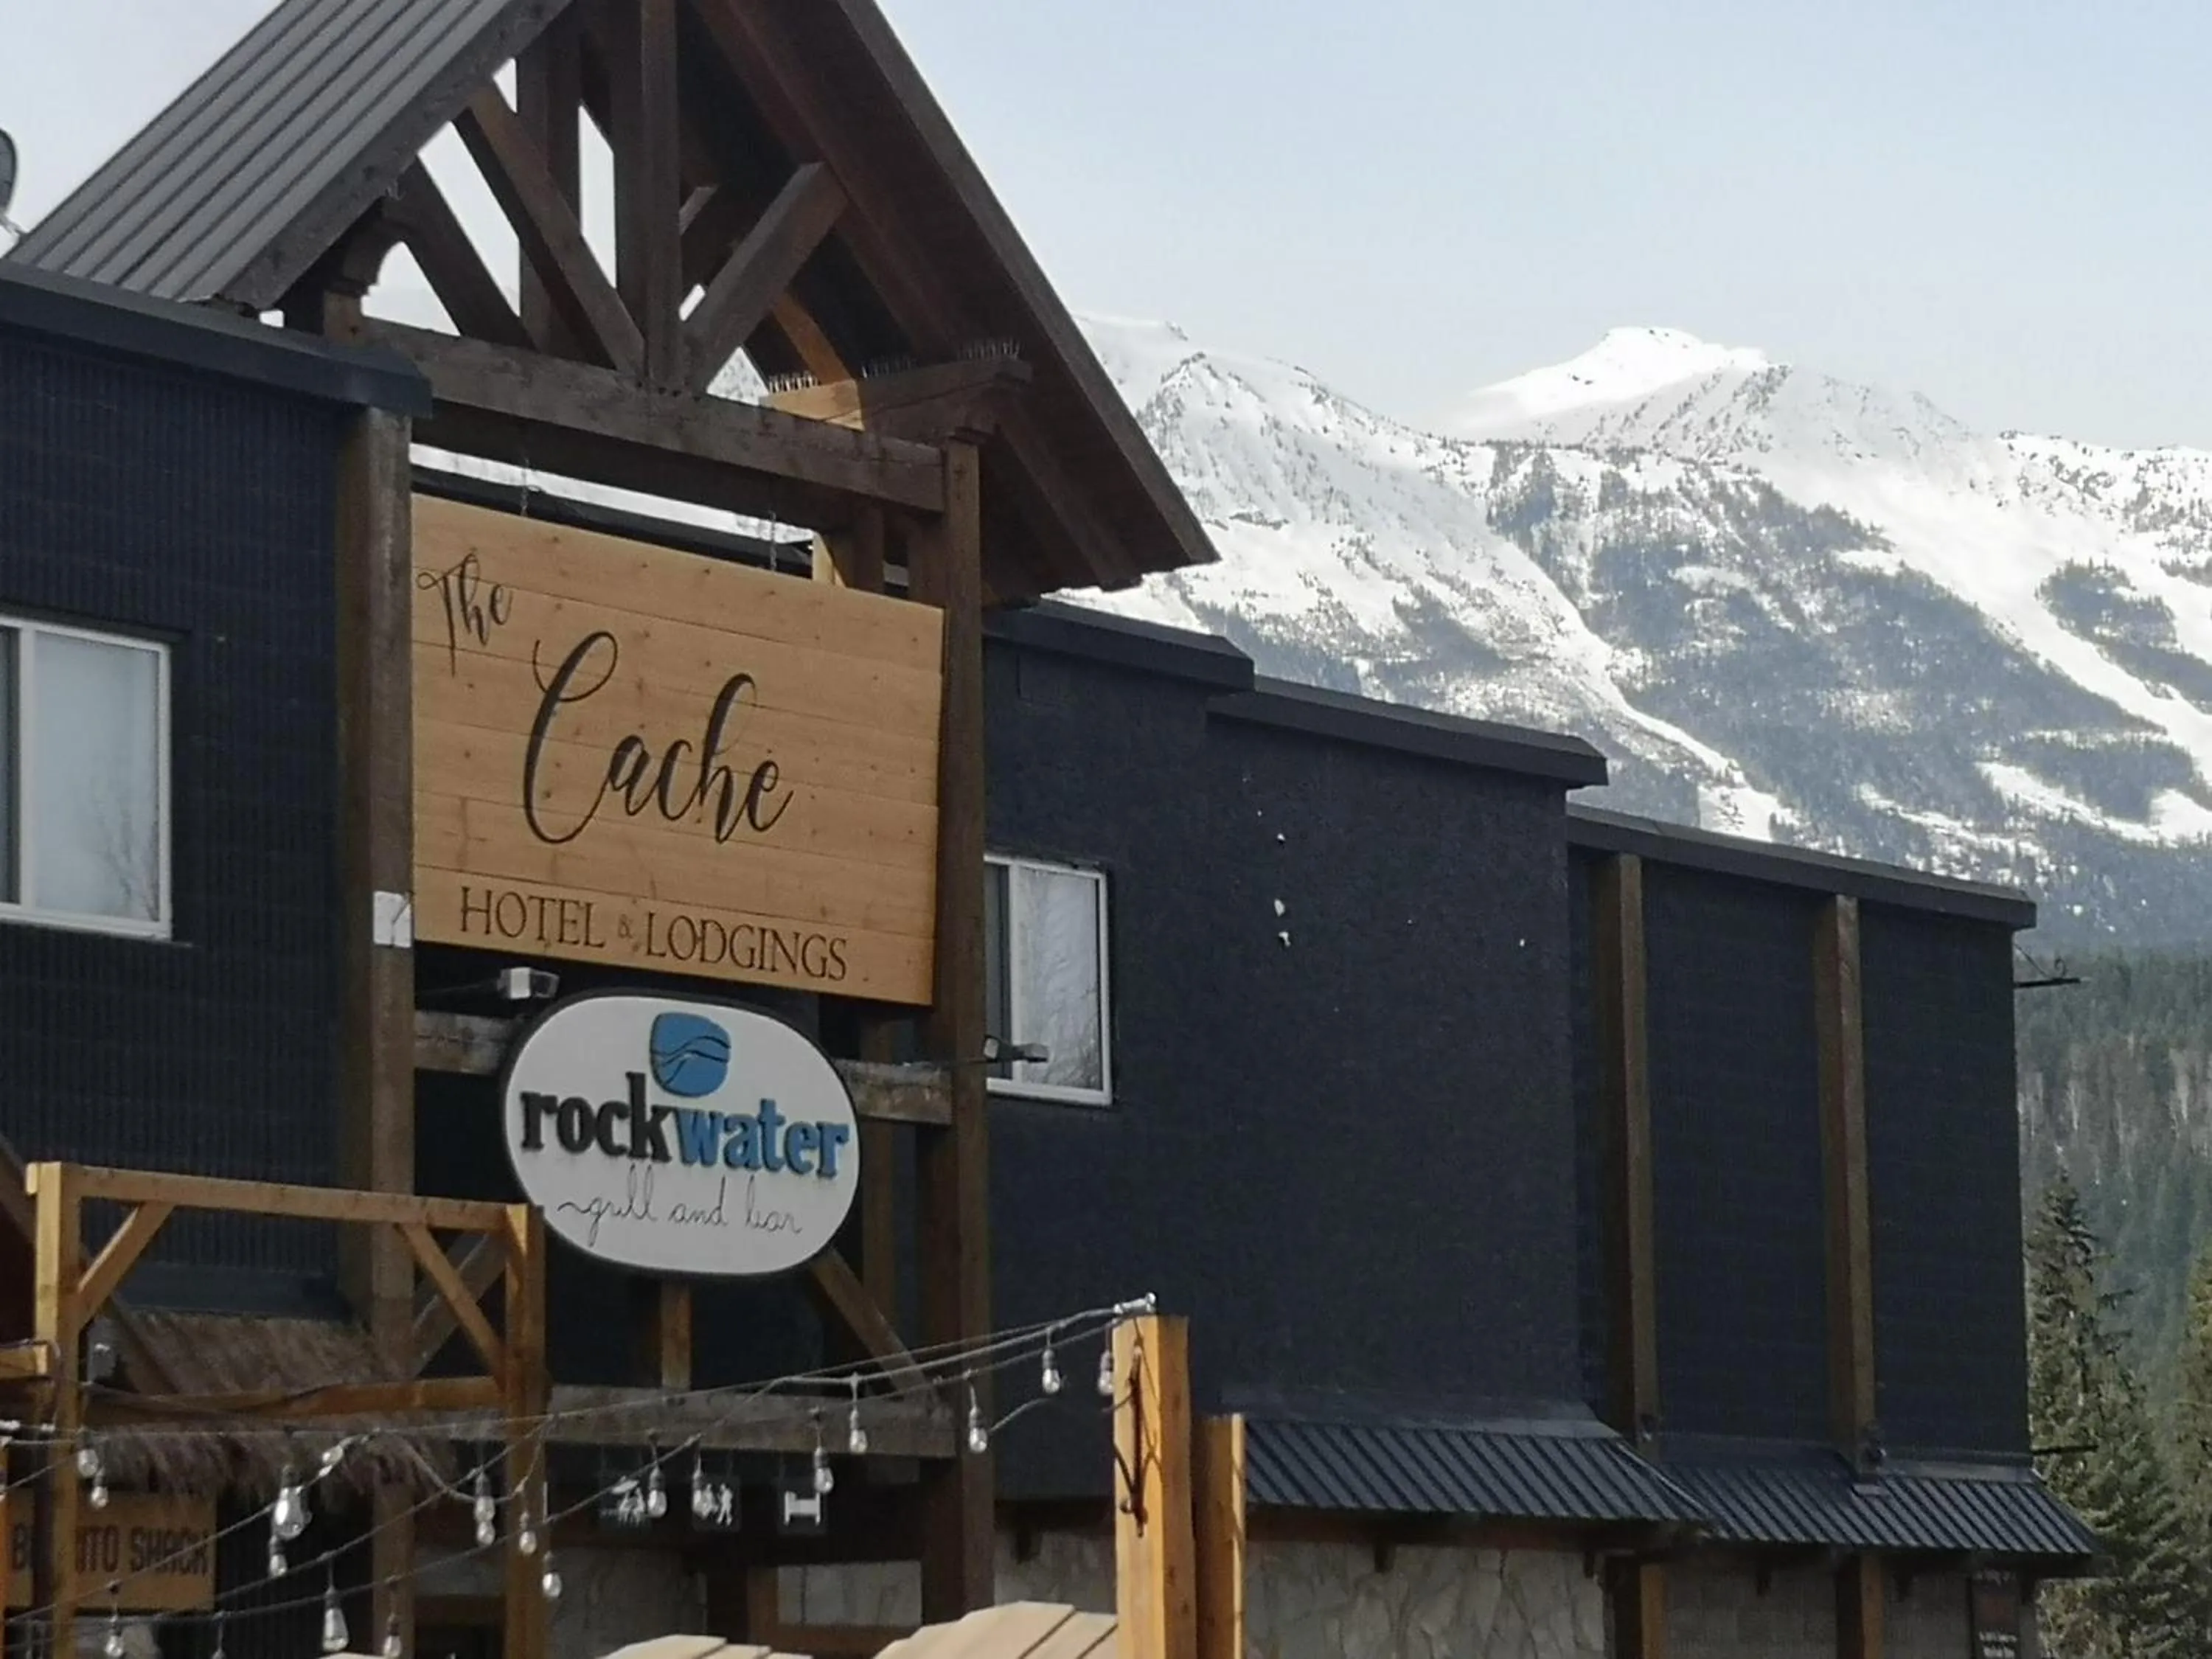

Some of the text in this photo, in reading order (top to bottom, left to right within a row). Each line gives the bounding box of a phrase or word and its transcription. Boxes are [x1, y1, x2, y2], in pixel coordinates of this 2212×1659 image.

[415, 552, 514, 677] The
[523, 630, 794, 845] Cache
[459, 886, 847, 981] HOTEL & LODGINGS
[519, 1071, 849, 1179] rockwater
[557, 1163, 803, 1248] grill and bar
